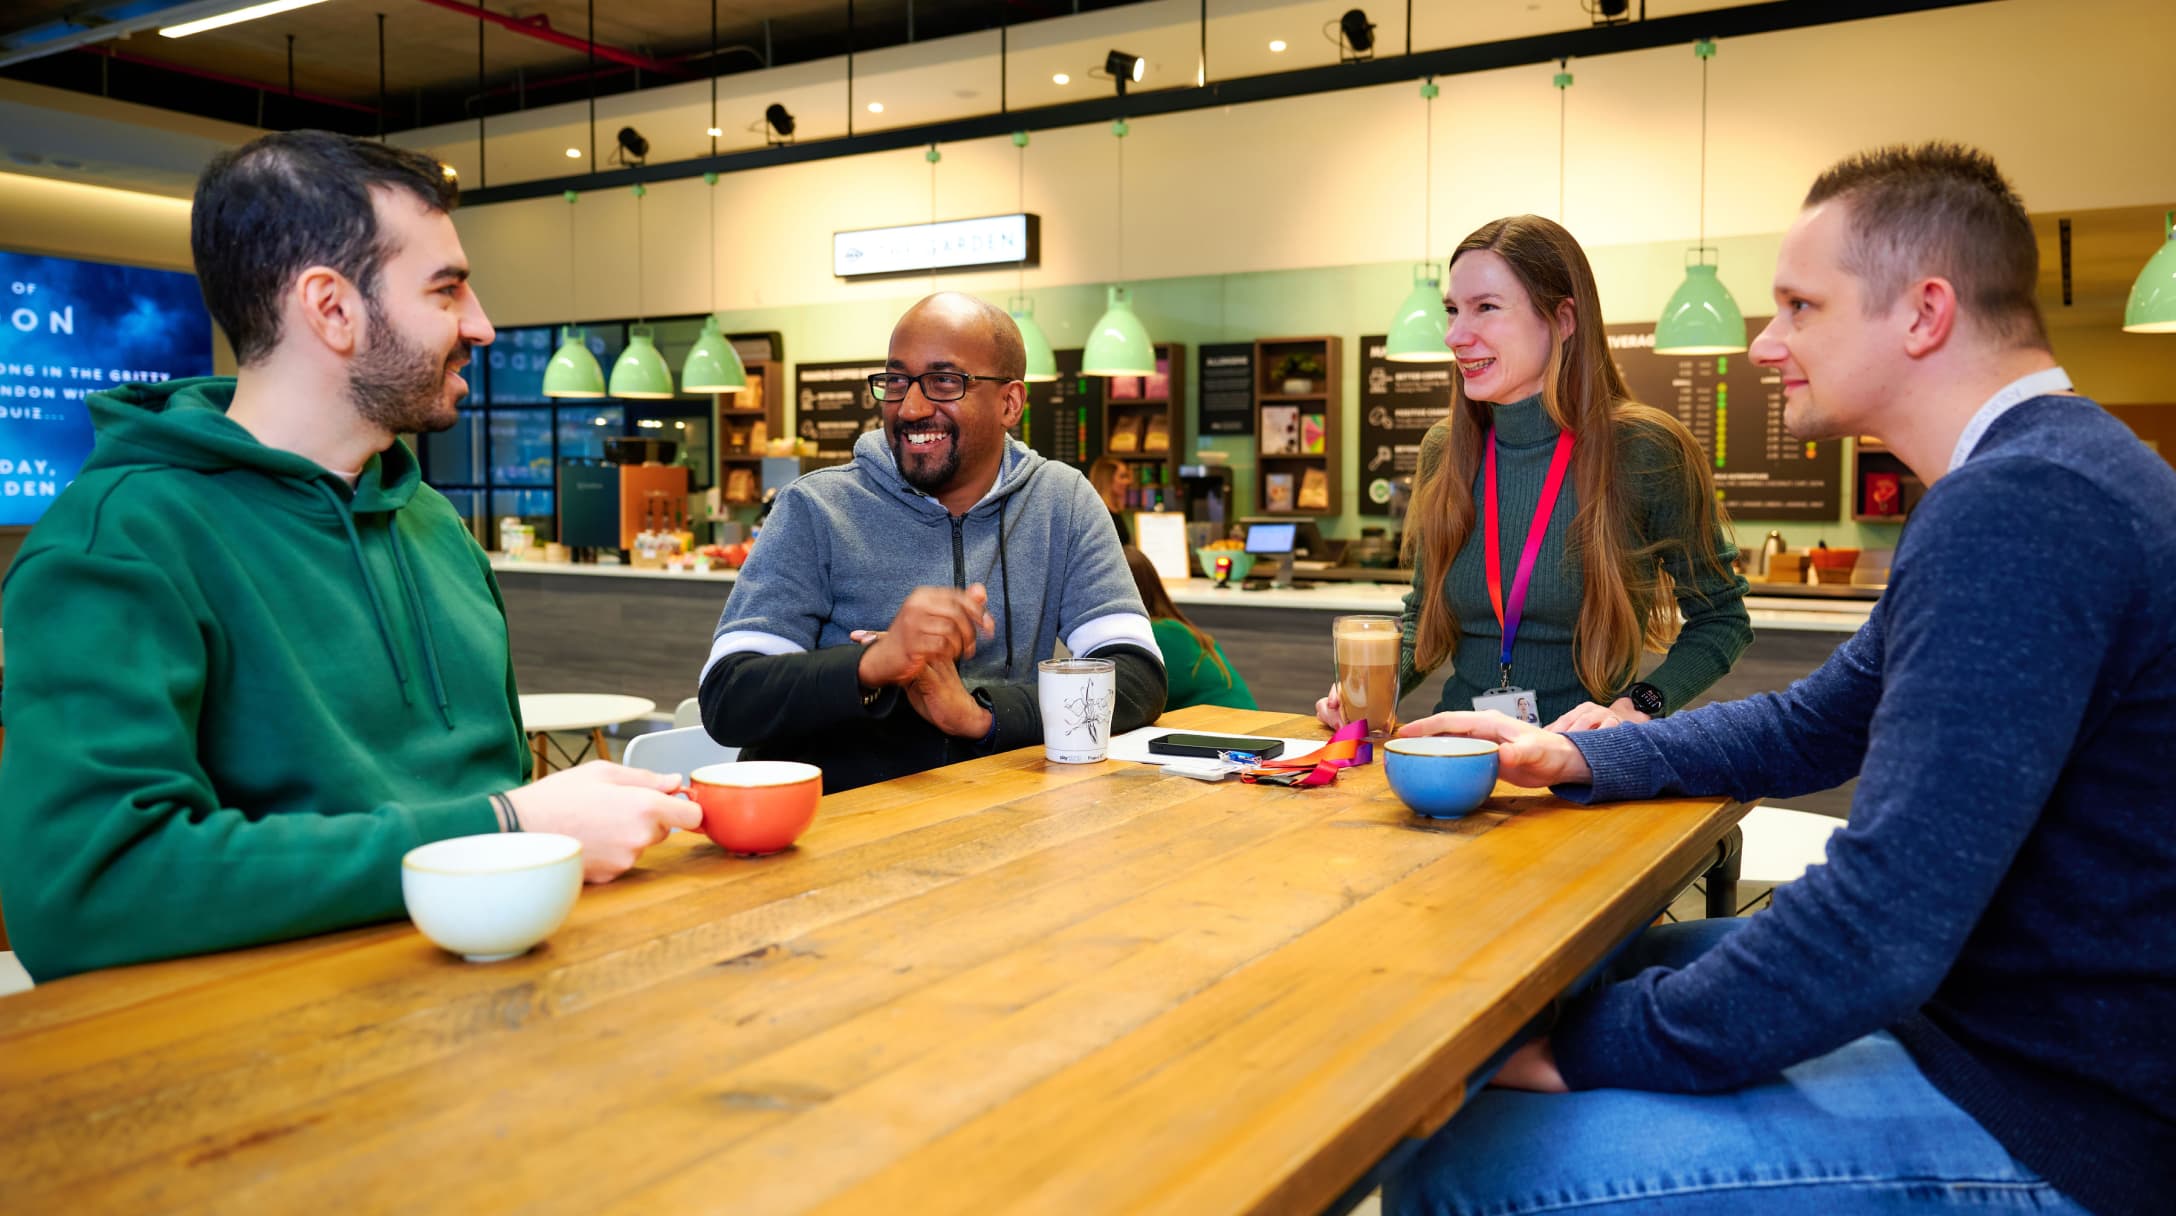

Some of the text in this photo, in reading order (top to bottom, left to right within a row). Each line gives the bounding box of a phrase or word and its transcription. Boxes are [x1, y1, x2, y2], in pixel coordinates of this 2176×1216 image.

[11, 281, 37, 295] OF
[0, 305, 74, 335] ON
[42, 364, 63, 378] IN
[70, 366, 102, 381] THE
[62, 387, 108, 400] WI
[0, 480, 56, 497] DEN
